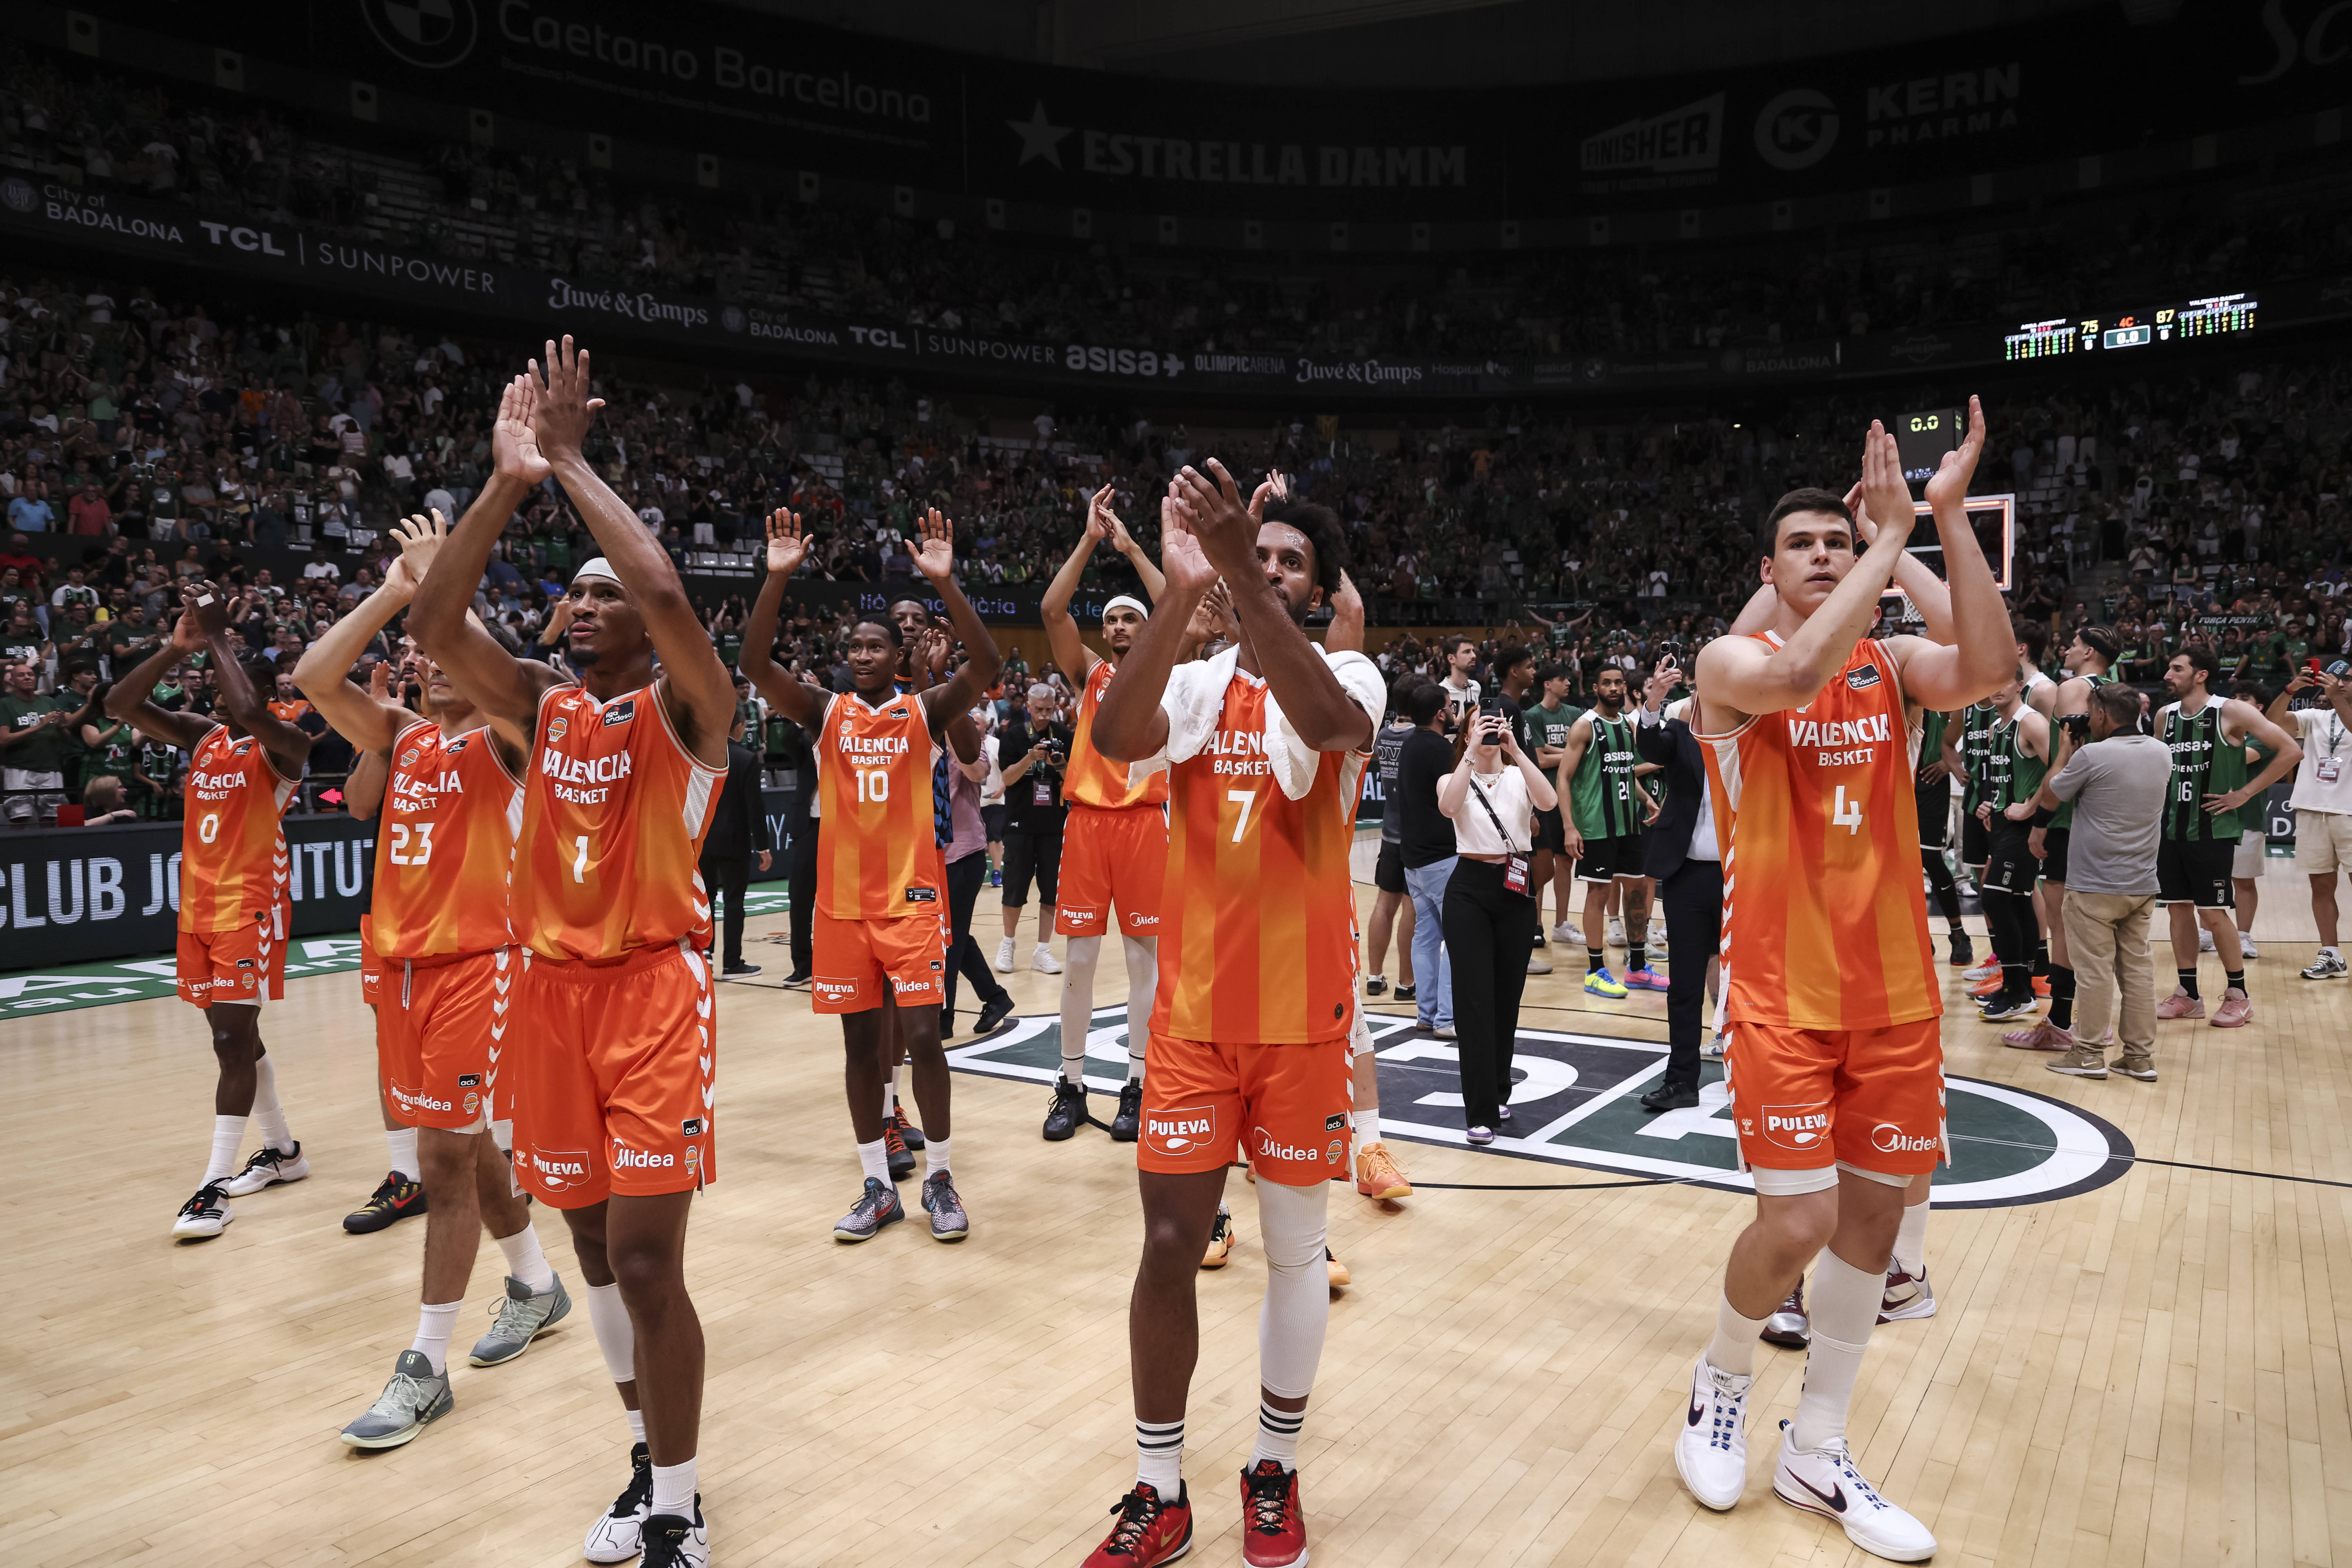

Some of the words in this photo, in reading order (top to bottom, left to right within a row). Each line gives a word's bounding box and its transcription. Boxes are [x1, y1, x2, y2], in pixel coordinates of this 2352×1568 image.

[498, 0, 698, 80] Caetano
[715, 46, 930, 123] Barcelona
[1867, 62, 2020, 122] KERN
[1867, 107, 2018, 149] PHARMA
[1586, 111, 1710, 167] FINISHER
[1083, 129, 1308, 185] ESTRELLA
[1318, 145, 1466, 187] DAMM
[44, 185, 80, 205] City
[88, 196, 105, 207] of
[46, 201, 184, 243] BADALONA
[199, 220, 286, 257] TCL
[319, 243, 495, 294] SUNPOWER
[549, 278, 612, 310] Juvé
[614, 292, 634, 318] &
[636, 292, 709, 328] Camps
[748, 308, 773, 324] City
[776, 312, 788, 324] of
[2156, 309, 2175, 324] 87
[750, 322, 838, 346] BADALONA
[2081, 319, 2099, 334] 75
[848, 325, 906, 349] TCL
[2117, 330, 2139, 345] 0.0
[928, 335, 1055, 364] SUNPOWER
[1296, 358, 1343, 383] Juvé
[1347, 363, 1362, 383] &
[1364, 359, 1422, 385] Camps
[1432, 363, 1483, 376] Hospital
[1746, 355, 1831, 373] BADALONA
[1910, 415, 1939, 432] 0.0
[2229, 615, 2261, 624] PENYA!
[1852, 675, 1879, 687] endesa
[606, 710, 618, 719] liga
[606, 712, 632, 724] endesa
[1789, 713, 1892, 747] VALENCIA
[1967, 730, 1990, 740] asis
[838, 736, 909, 753] VALENCIA
[542, 746, 632, 785] VALENCIA
[851, 755, 892, 765] BASKET
[1818, 748, 1873, 766] BASKET
[1214, 760, 1272, 775] BASKET
[1602, 764, 1635, 774] JOVENTT
[2172, 761, 2210, 773] OVENTUT
[555, 783, 609, 804] BASKET
[855, 770, 889, 803] 10
[1651, 779, 1659, 795] 9
[2178, 781, 2192, 802] 16
[1227, 790, 1256, 843] 7
[1833, 785, 1863, 835] 4
[200, 813, 219, 844] 0
[390, 822, 436, 866] 23
[573, 835, 589, 884] 1
[1509, 866, 1522, 875] PREMSA
[1062, 909, 1094, 920] PULEVA
[816, 982, 855, 993] PULEVA
[894, 981, 930, 995] Midea
[685, 1125, 698, 1134] acb
[1149, 1118, 1210, 1136] PULEVA
[1327, 1122, 1341, 1130] acb
[1768, 1113, 1827, 1131] PULEVA
[1258, 1138, 1318, 1161] Midea
[1883, 1134, 1937, 1152] Midea
[533, 1153, 584, 1175] PULEVA
[614, 1147, 674, 1170] Midea
